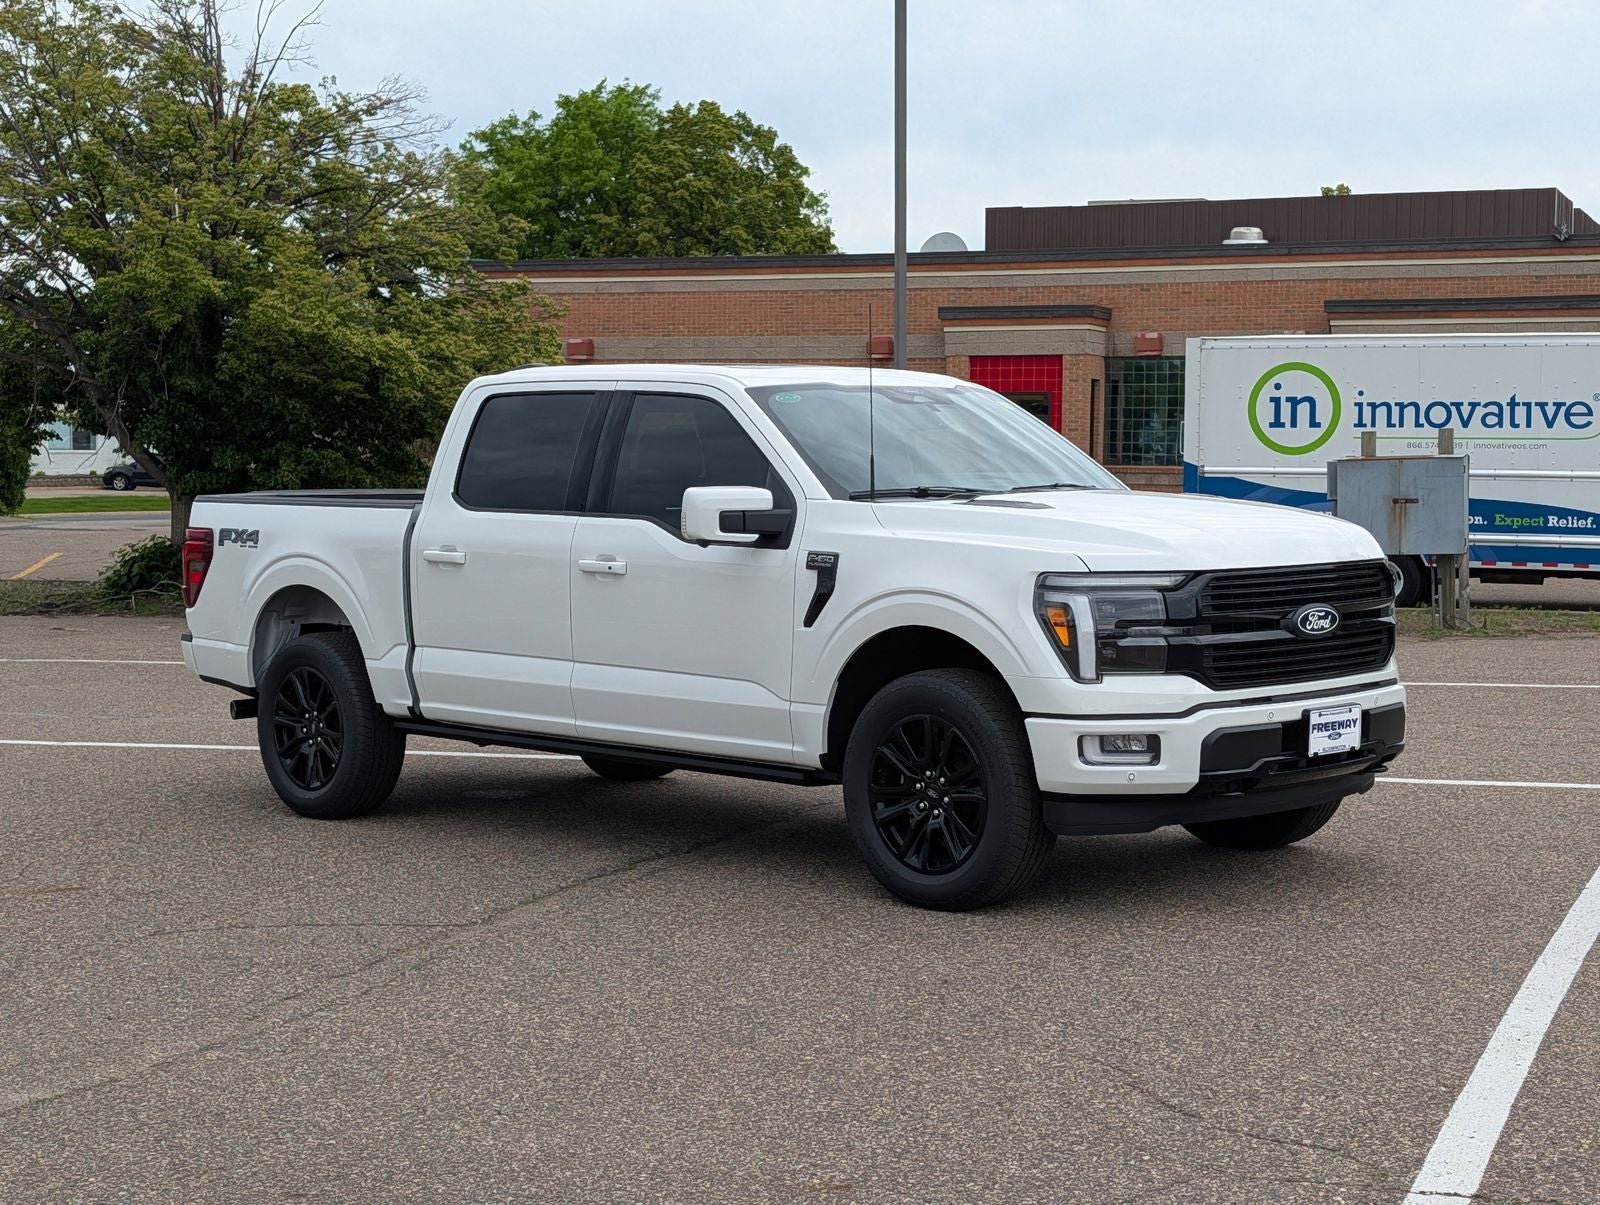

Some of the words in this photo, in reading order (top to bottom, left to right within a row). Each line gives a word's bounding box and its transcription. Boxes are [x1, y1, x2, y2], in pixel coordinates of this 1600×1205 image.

[1268, 382, 1322, 429] in
[1494, 514, 1545, 529] Expect
[1547, 515, 1597, 528] Relief.
[218, 527, 260, 547] FX4
[1306, 611, 1332, 630] Ford
[1311, 717, 1359, 735] FREEWAY
